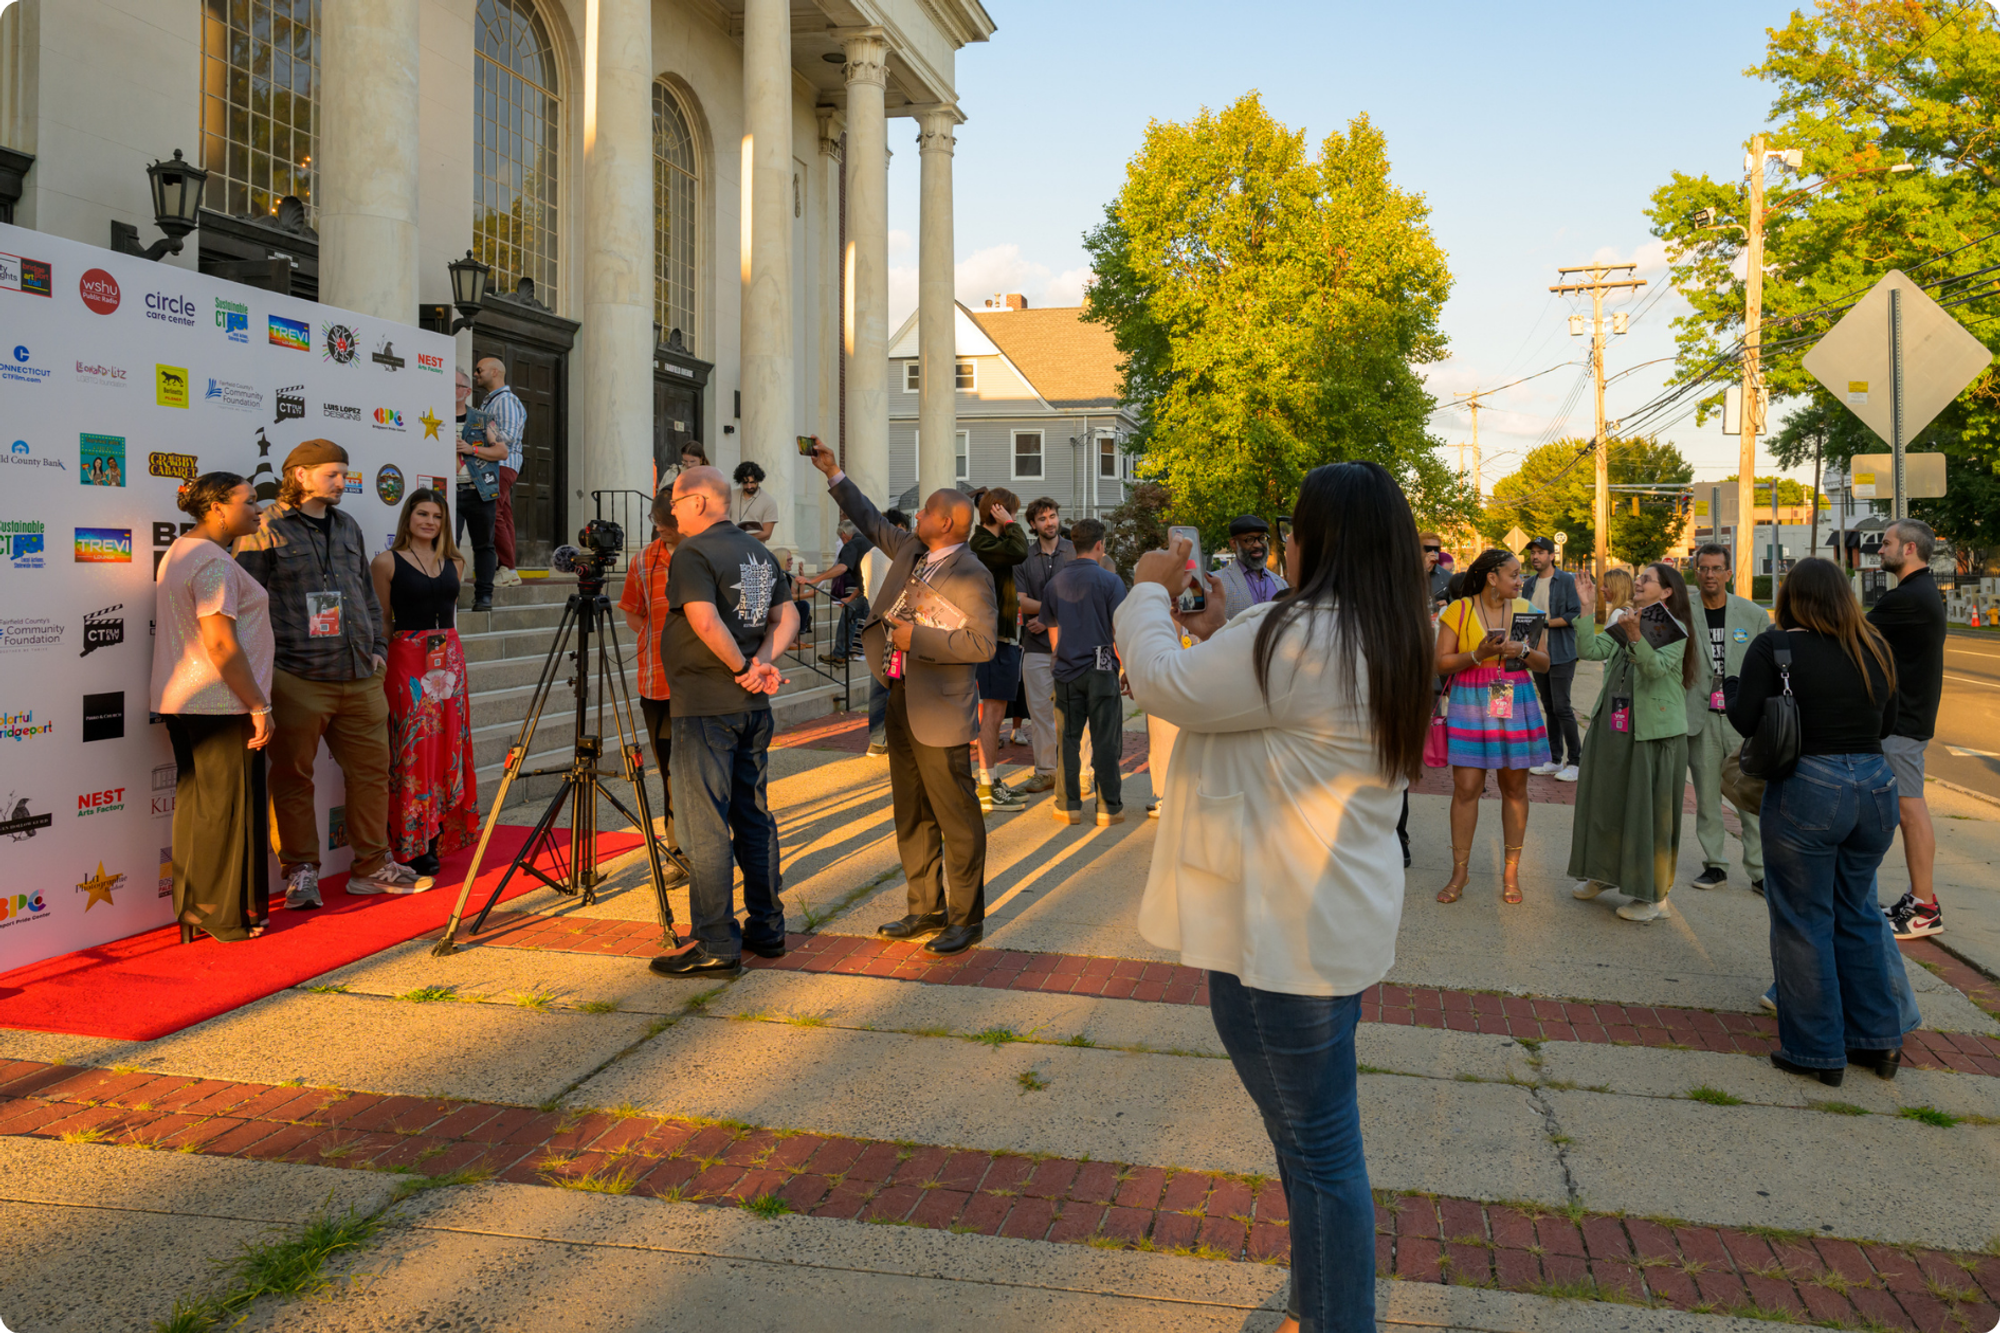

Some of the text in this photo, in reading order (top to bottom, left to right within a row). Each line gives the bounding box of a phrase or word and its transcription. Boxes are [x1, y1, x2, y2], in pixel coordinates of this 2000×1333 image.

[145, 291, 195, 317] circle
[215, 297, 248, 314] Sustainable
[146, 311, 195, 327] care center
[215, 310, 226, 328] CT
[270, 324, 308, 342] TREVI
[418, 353, 443, 368] NEST
[224, 387, 263, 402] Community
[223, 395, 260, 408] Foundation
[279, 402, 292, 414] CT
[323, 403, 361, 414] LUIS LOPEZ
[323, 410, 361, 422] DESIGNS
[11, 456, 41, 467] County
[43, 459, 62, 468] Bank
[150, 453, 197, 468] CRABBY
[150, 464, 197, 479] CABARET
[77, 539, 129, 552] TREVI
[7, 625, 65, 635] Community
[87, 629, 106, 642] CT
[4, 634, 60, 645] Foundation
[78, 788, 125, 810] NEST
[78, 803, 125, 817] Arts Factory
[84, 873, 99, 885] La
[15, 917, 31, 925] Pride
[32, 912, 51, 920] Center
